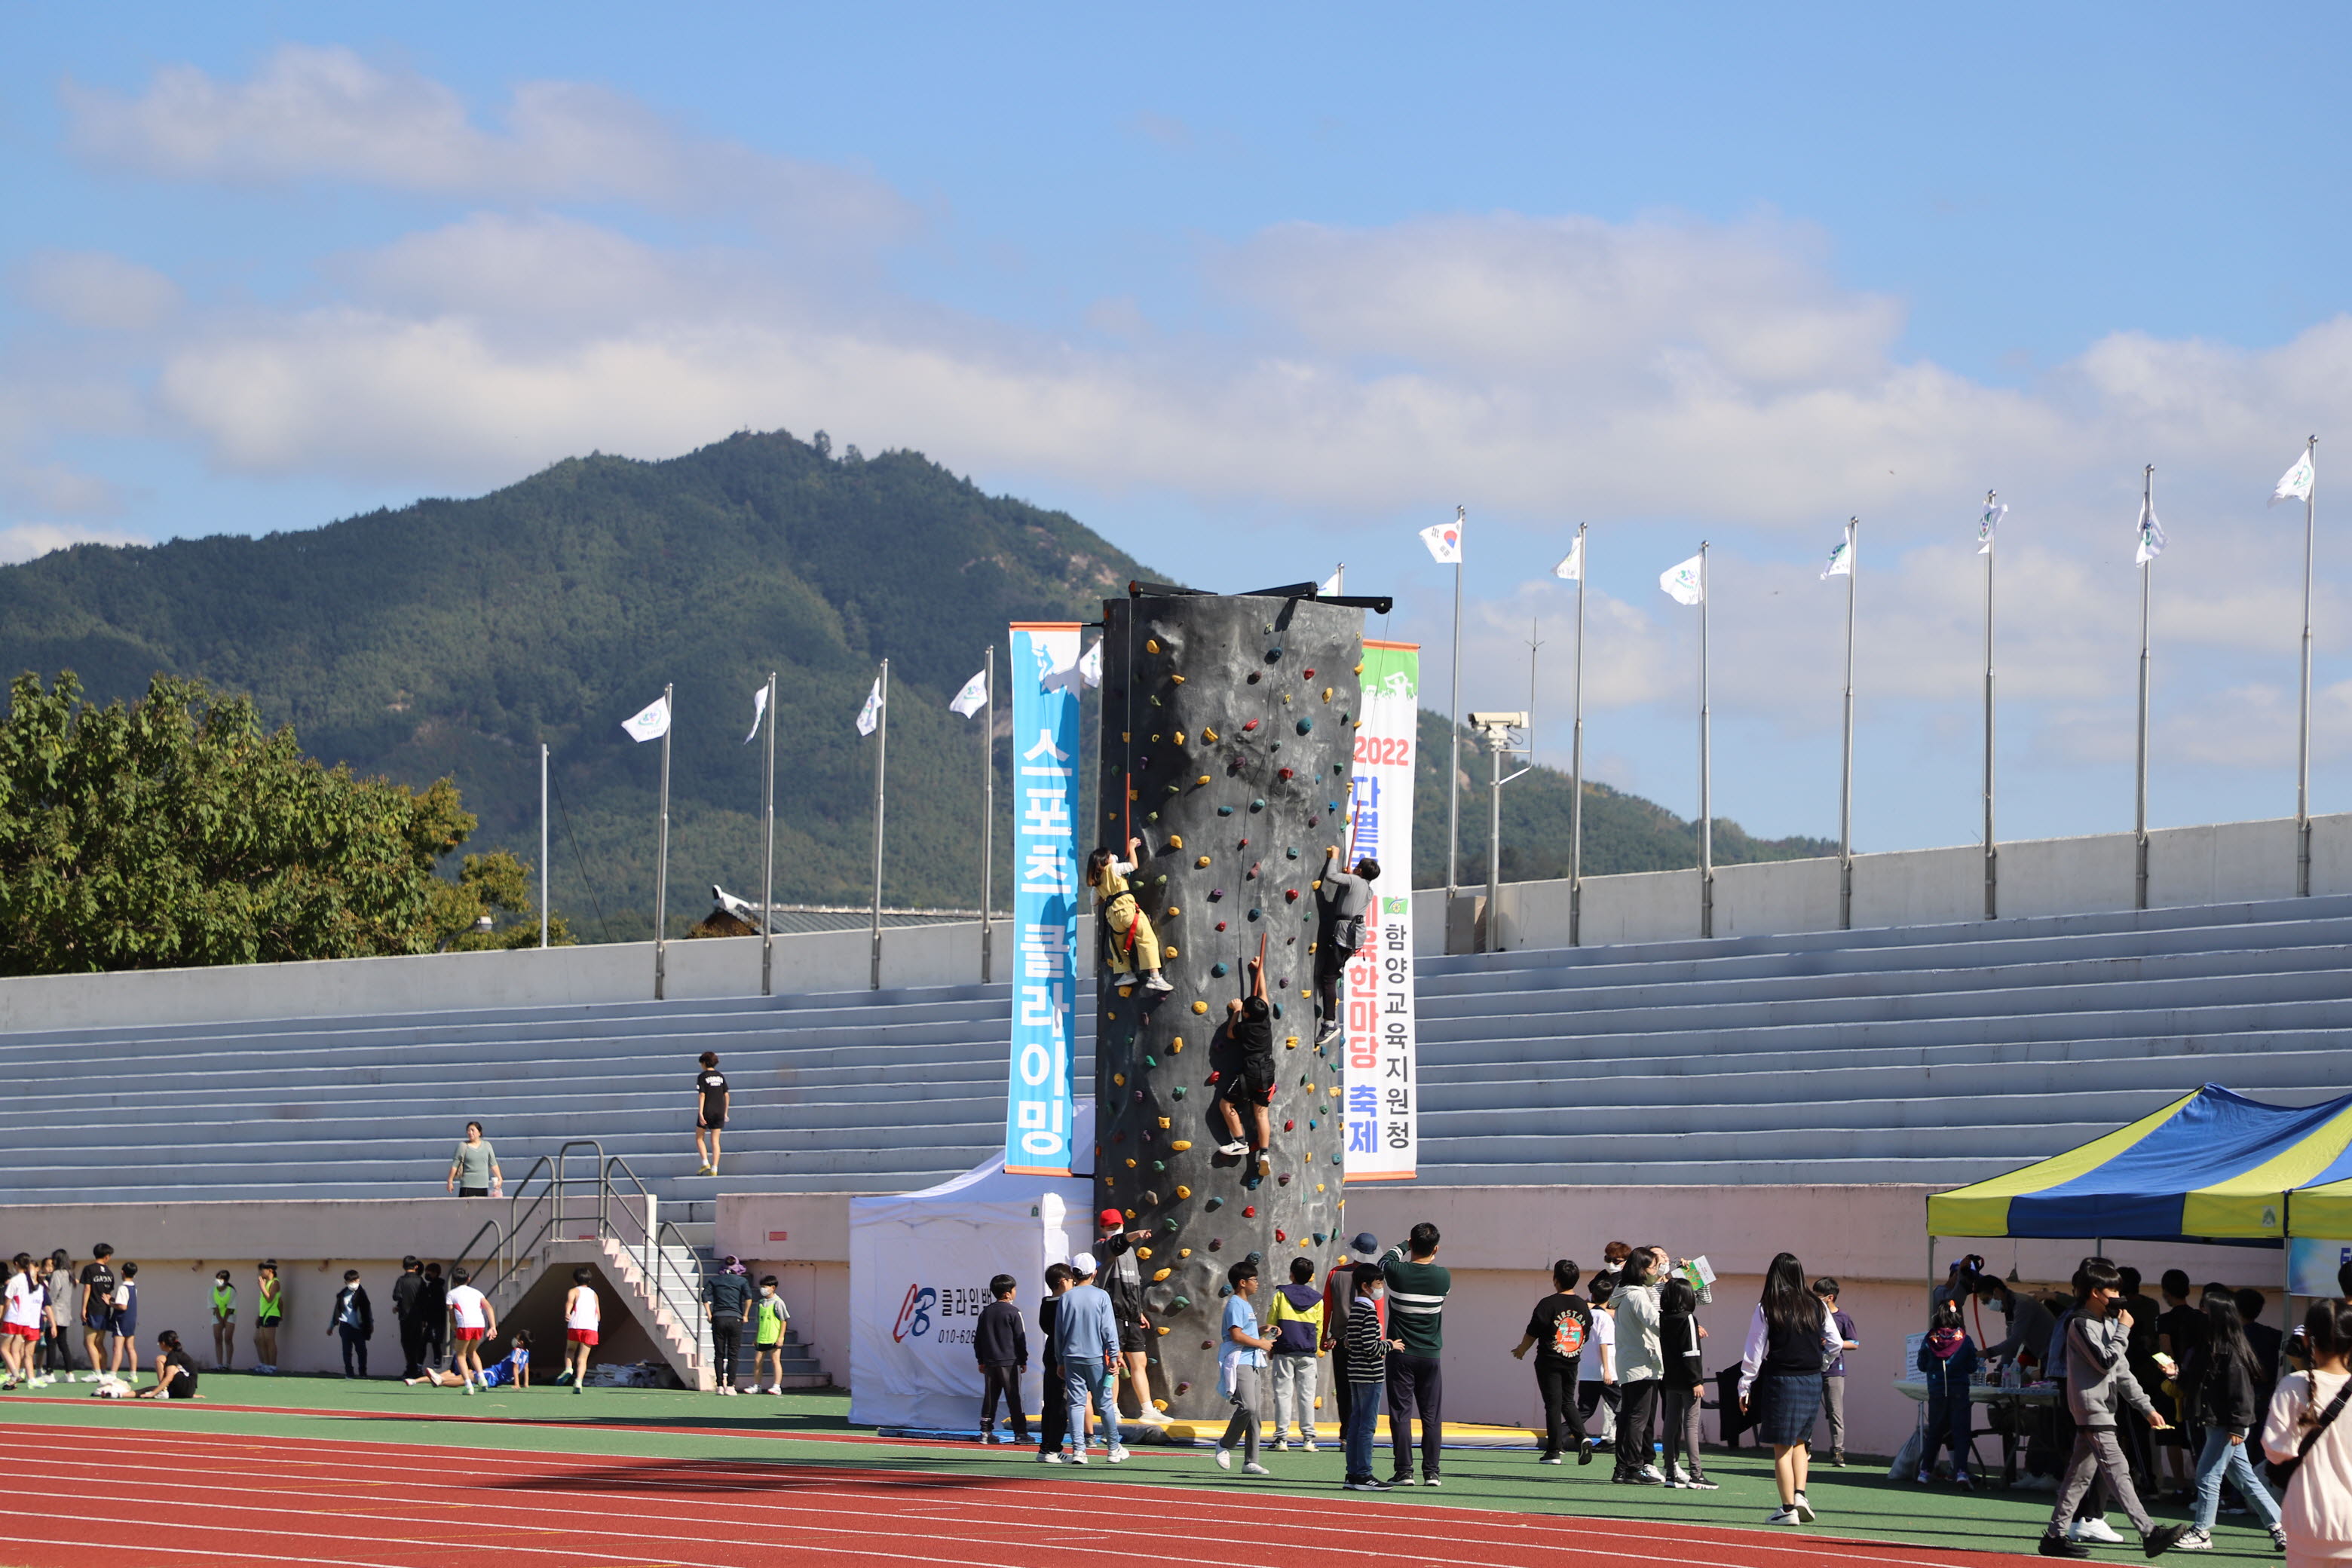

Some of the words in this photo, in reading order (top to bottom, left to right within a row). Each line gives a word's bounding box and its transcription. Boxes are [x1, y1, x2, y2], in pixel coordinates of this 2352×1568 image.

[1021, 729, 1073, 893] 스포츠
[1354, 736, 1409, 767] 2022
[1018, 923, 1070, 1156] 클라이밍
[1349, 1084, 1379, 1153] 축제
[1384, 924, 1410, 1150] 함양교육지원청
